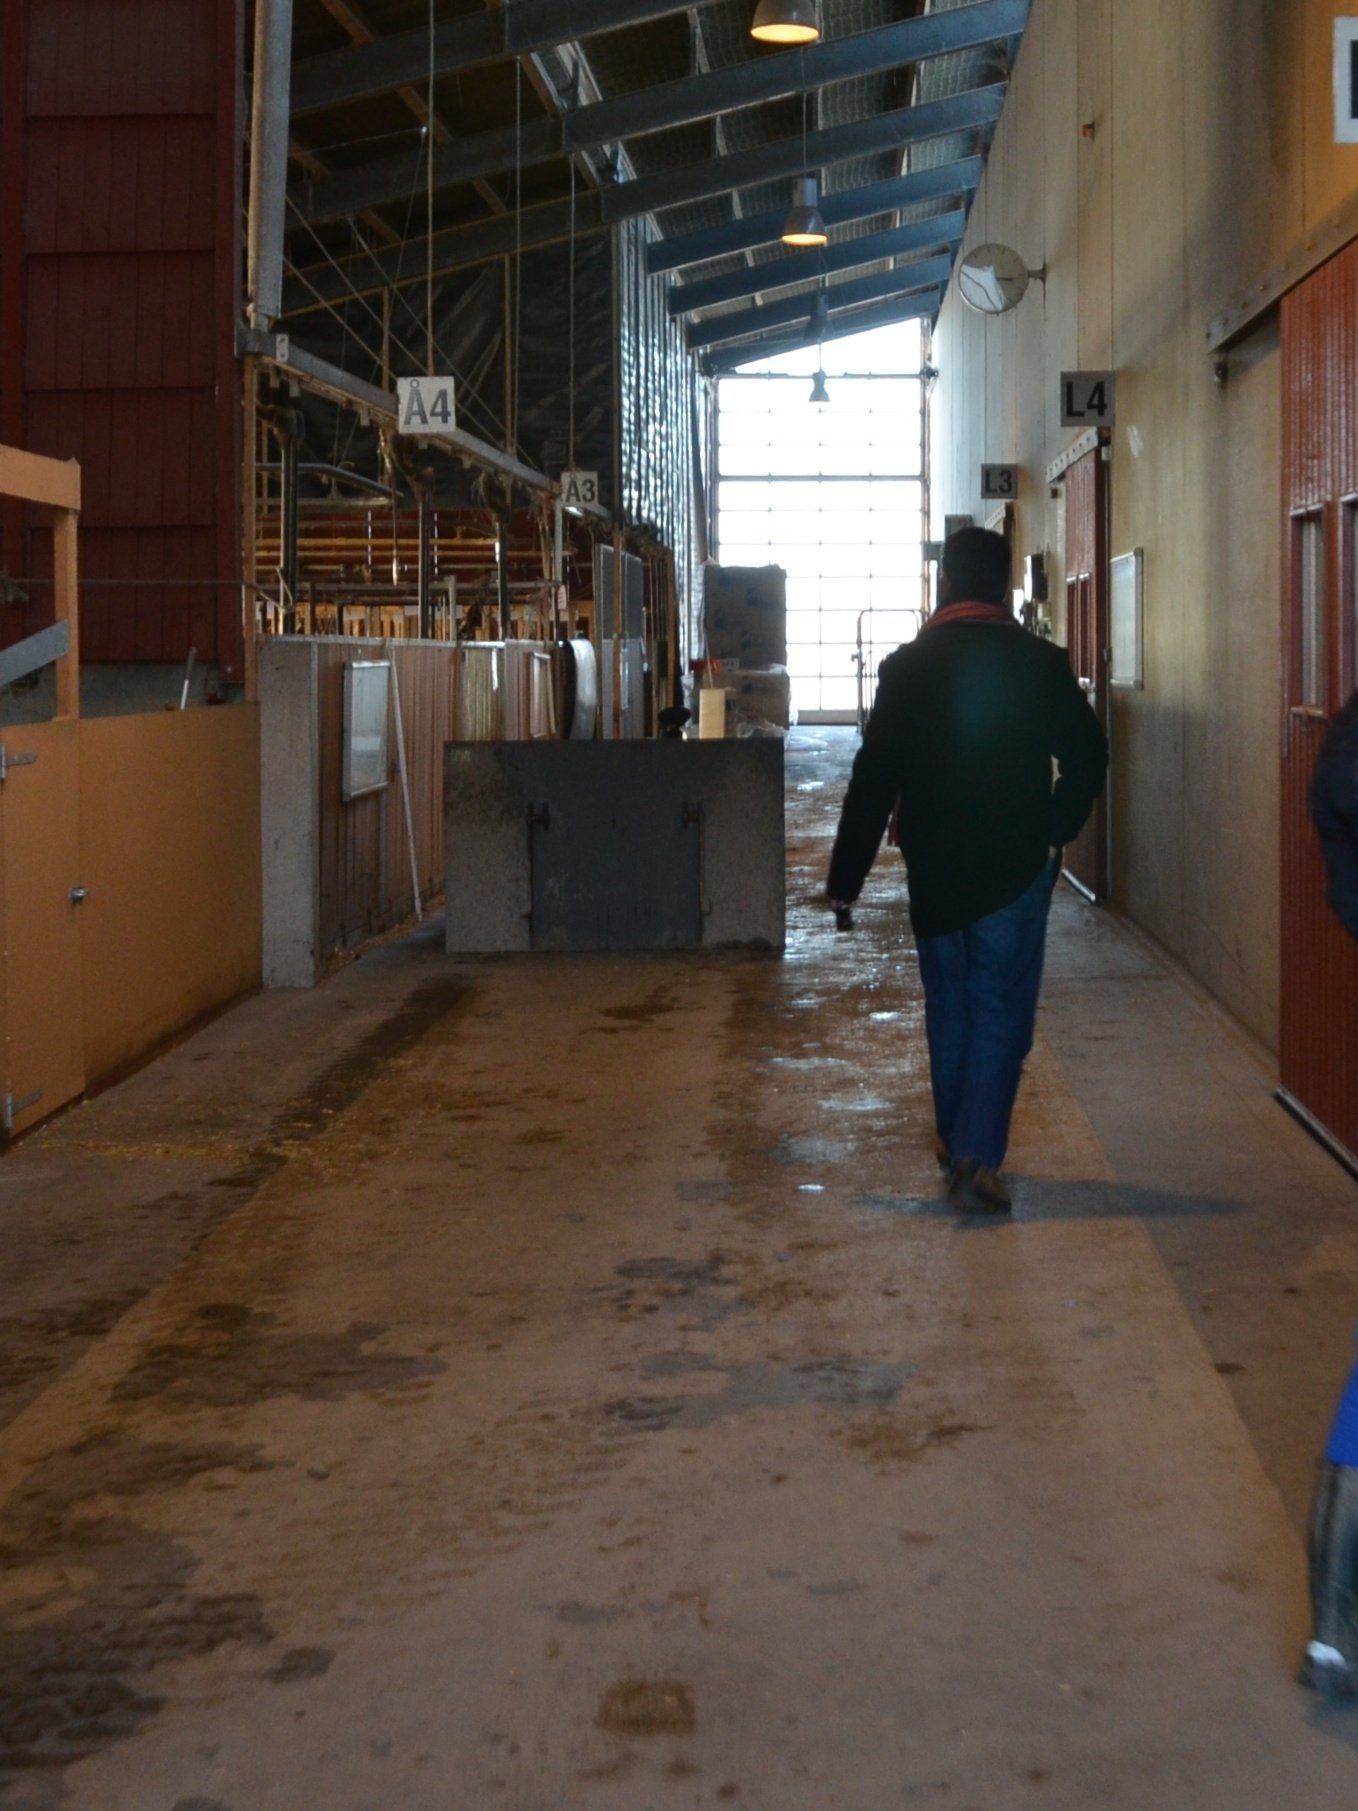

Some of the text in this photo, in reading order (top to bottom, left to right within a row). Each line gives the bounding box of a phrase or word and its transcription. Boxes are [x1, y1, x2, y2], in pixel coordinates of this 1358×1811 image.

[403, 379, 452, 425] Å4
[1066, 381, 1108, 417] L4
[985, 469, 1013, 494] L3
